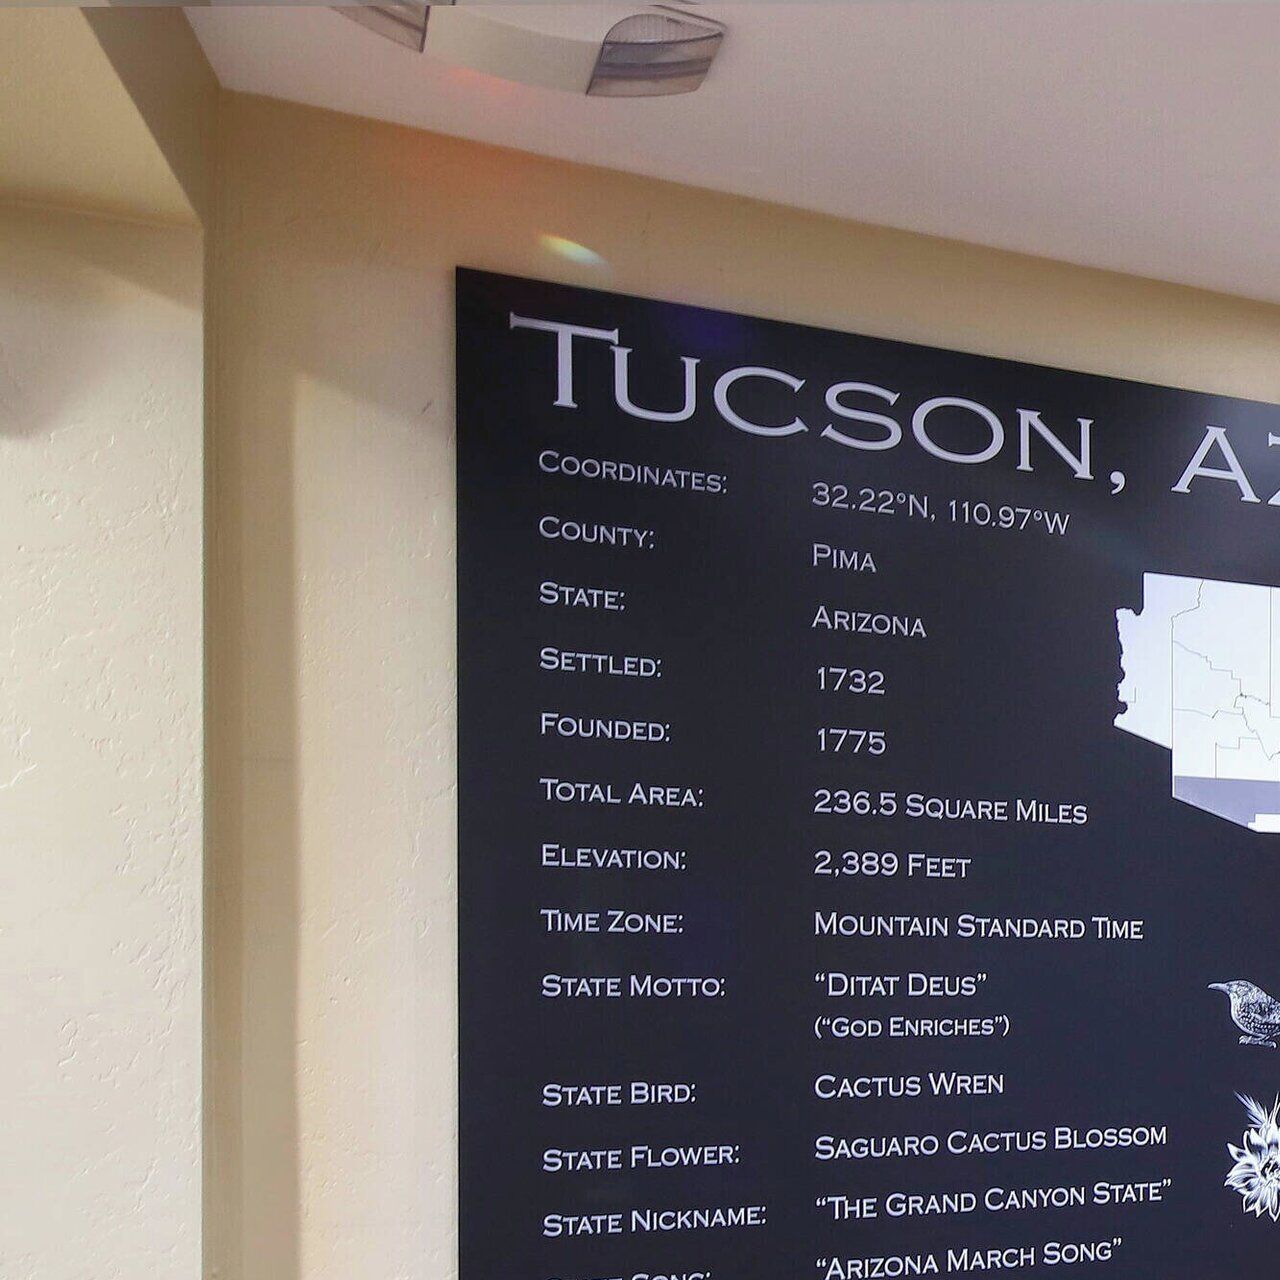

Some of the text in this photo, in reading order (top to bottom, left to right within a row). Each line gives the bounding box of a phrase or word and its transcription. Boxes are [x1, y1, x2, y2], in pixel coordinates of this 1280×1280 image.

[510, 311, 1127, 495] TUCSON,
[538, 450, 728, 494] COORDINATES:
[539, 516, 655, 549] COUNTY:
[813, 543, 878, 573] PIMA
[539, 581, 626, 611] STATE:
[811, 605, 928, 638] ARIZONA
[539, 647, 663, 678] SETTLED:
[817, 666, 886, 695] 1732
[541, 712, 671, 742] FOUNDED:
[817, 728, 887, 755] 1775
[539, 777, 704, 807] TOTAL AREA:
[813, 789, 1089, 825] 236.5 SQUARE MILES
[542, 843, 687, 870] ELEVATION:
[814, 850, 973, 878] 2,389 FEET
[539, 908, 685, 934] TIME ZONE:
[814, 911, 1145, 940] MOUNTAIN STANDARD TIME
[541, 974, 726, 997] STATE MOTTO:
[542, 1081, 697, 1107] STATE BIRD:
[814, 1072, 1005, 1099] CACTUS WREN
[542, 1144, 741, 1172] STATE FLOWER:
[814, 1126, 1168, 1160] SAGUARO CACTUS BLOSSOM
[885, 1192, 978, 1217] GRAND
[984, 1186, 1086, 1211] CANYON
[542, 1206, 768, 1237] STATE NICKNAME:
[947, 1247, 1036, 1272] MARCH
